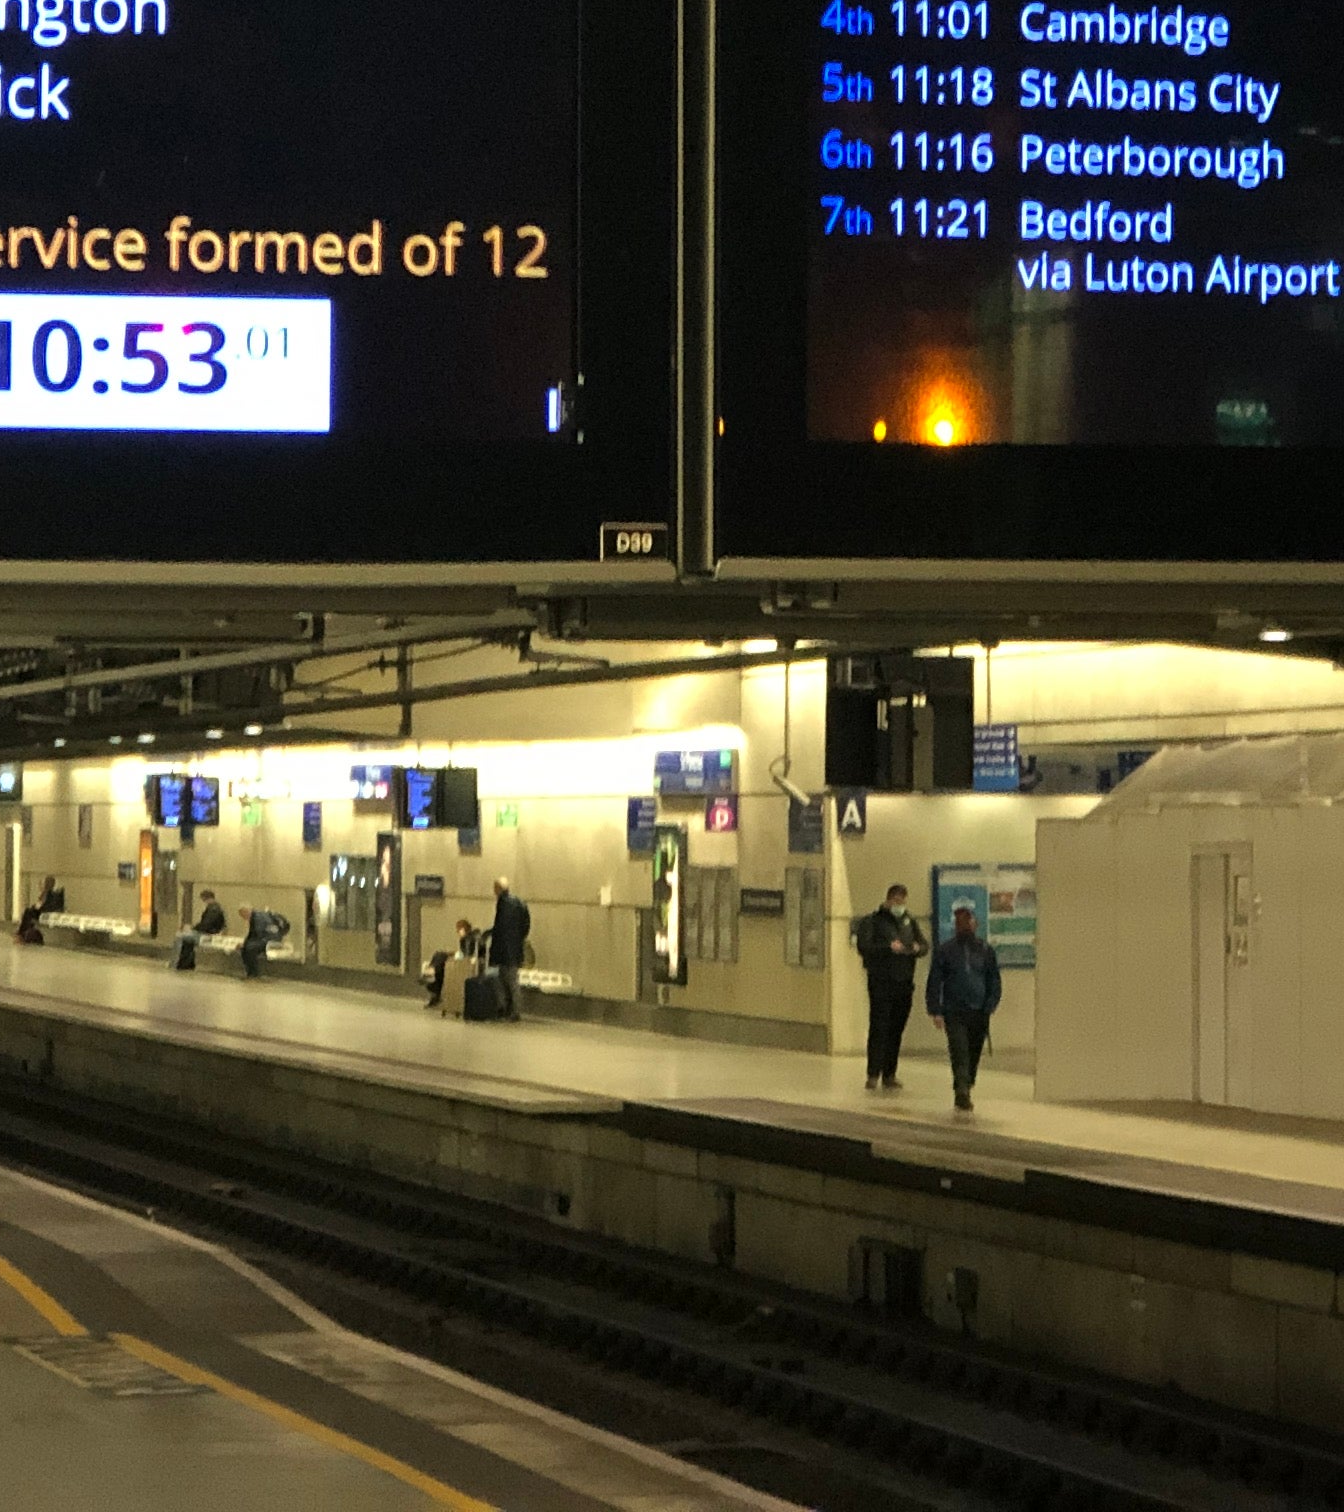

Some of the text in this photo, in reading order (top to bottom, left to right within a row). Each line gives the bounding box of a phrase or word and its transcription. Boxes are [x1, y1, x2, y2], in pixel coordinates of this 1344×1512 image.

[1020, 1, 1230, 57] Cambridge
[821, 61, 1281, 124] 5th 11:18 St Albans City
[820, 128, 1285, 190] 6th 11:16 Peterborough
[164, 215, 383, 276] formed
[403, 221, 465, 277] of
[483, 225, 547, 278] 12
[820, 195, 1173, 244] 7th 11:21 Bedford
[1017, 250, 1074, 292] via
[1084, 251, 1195, 294] Luton
[1204, 254, 1341, 305] Airport
[841, 798, 863, 829] A
